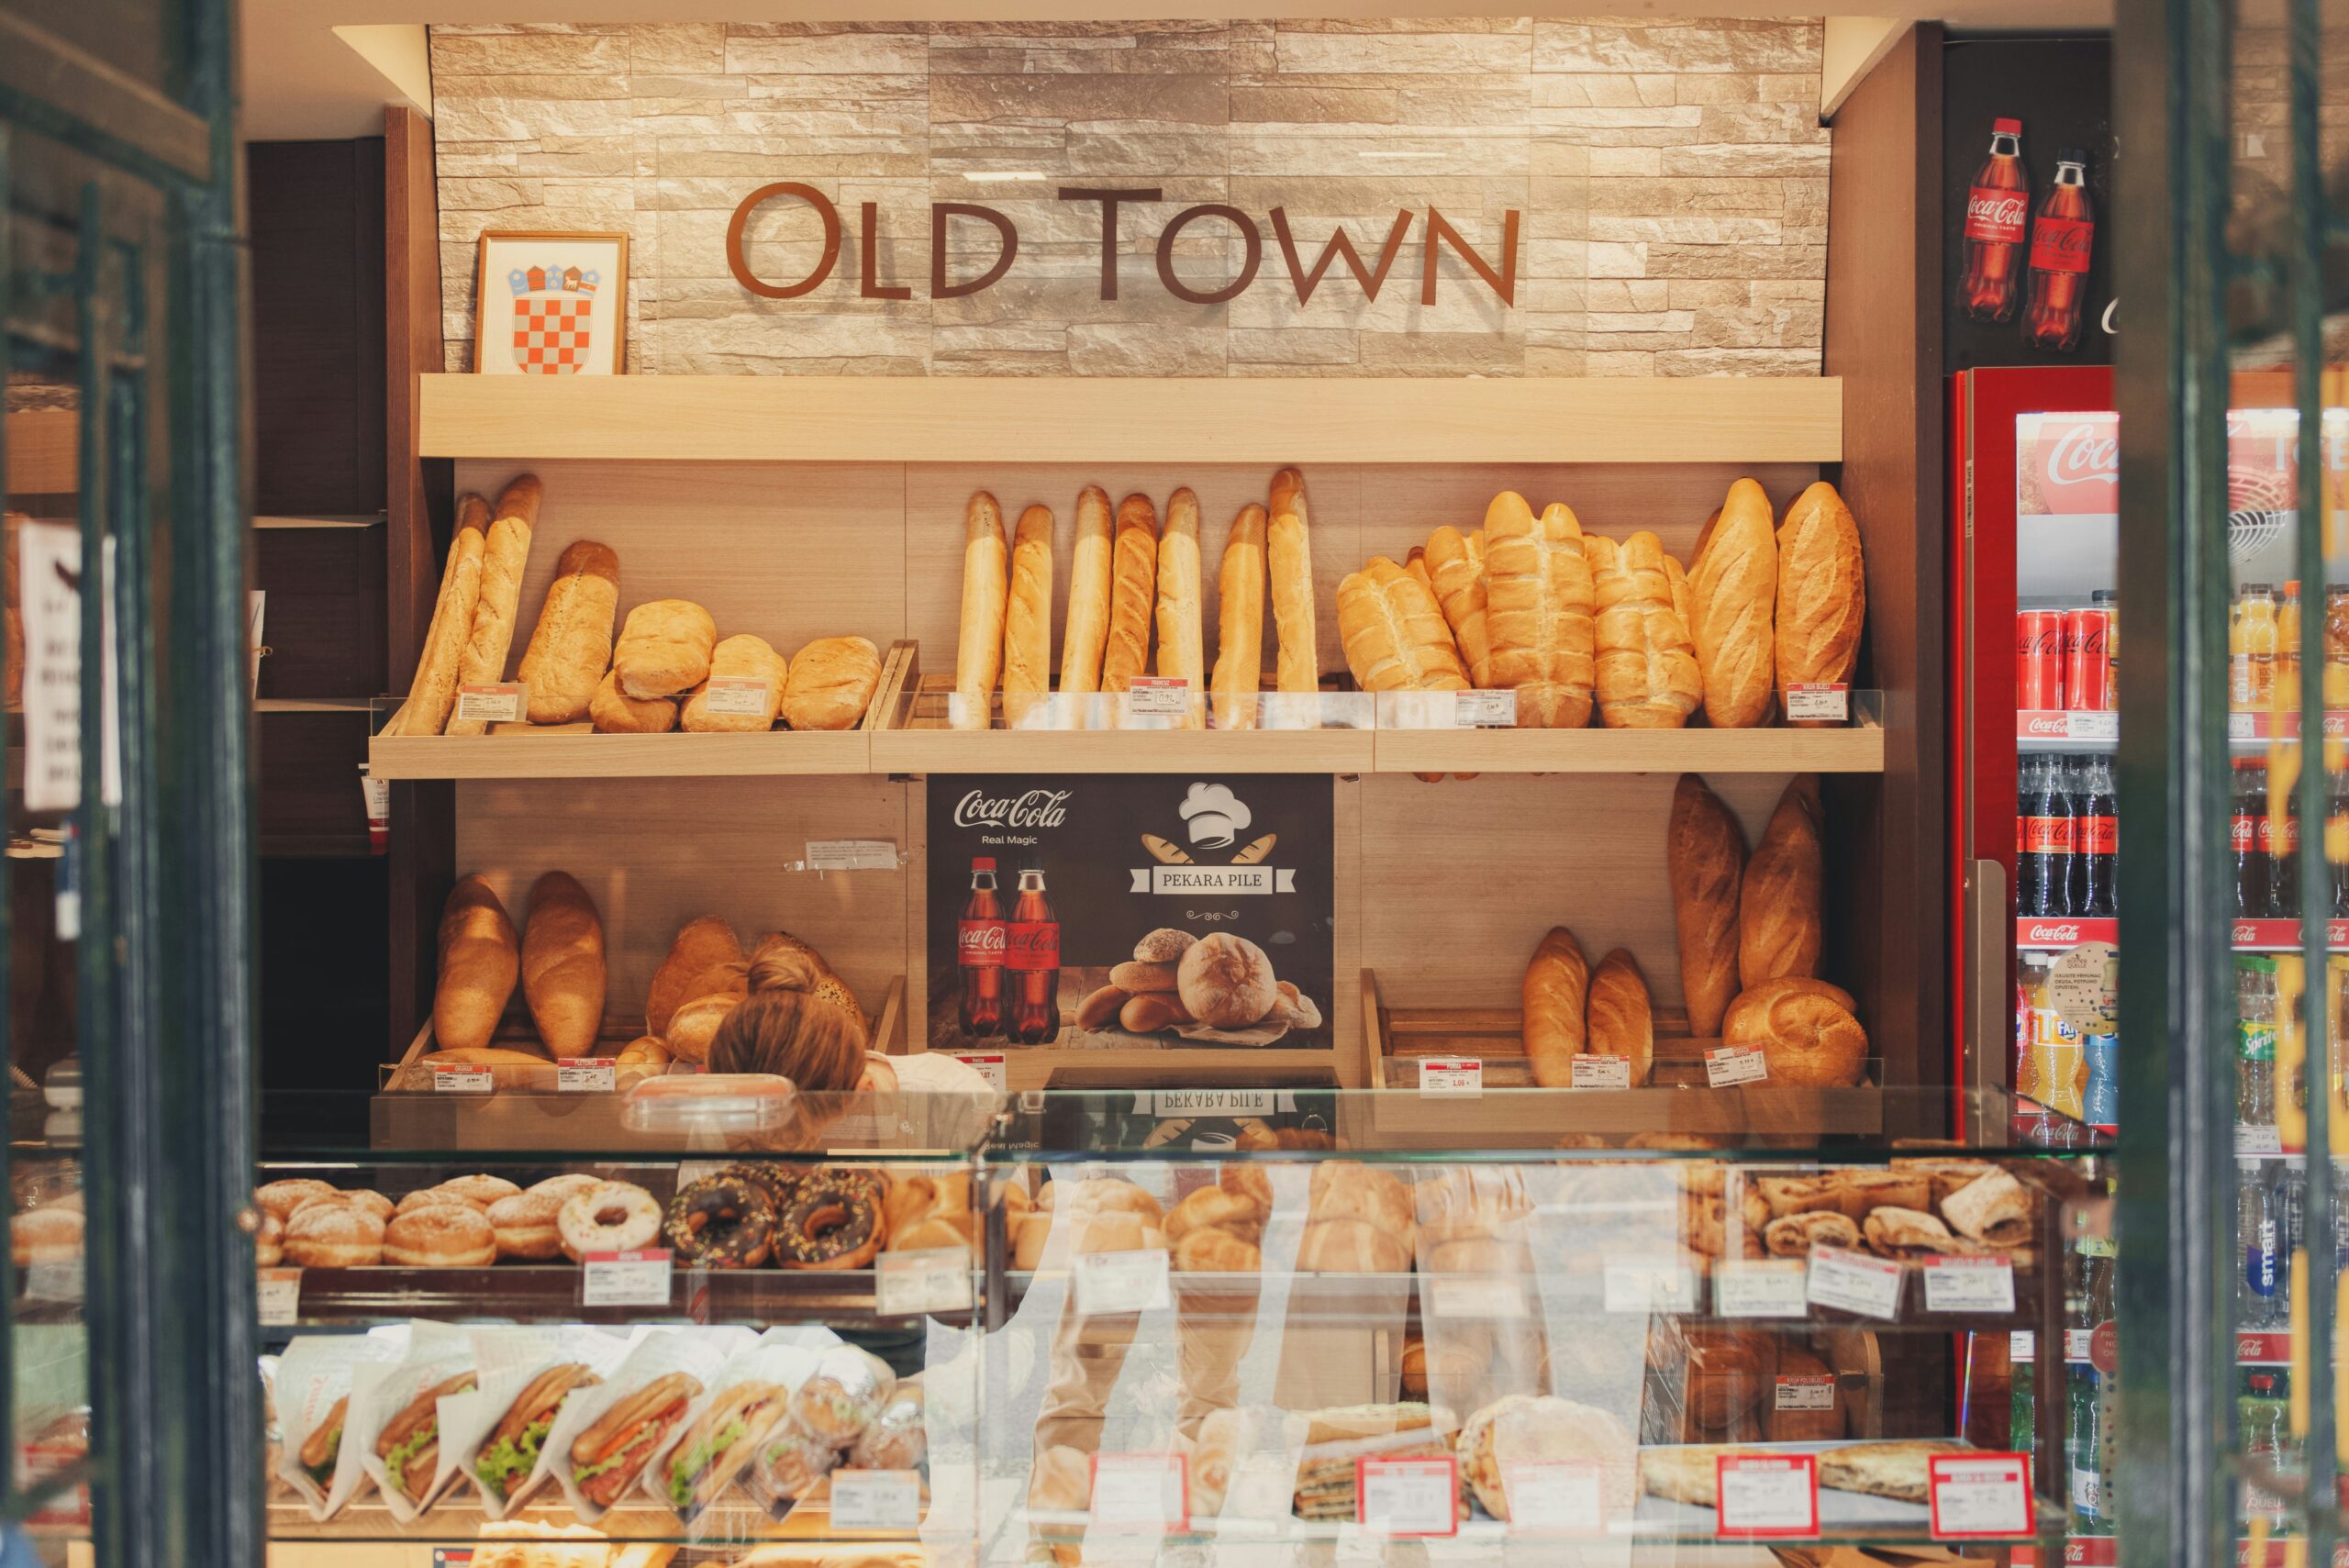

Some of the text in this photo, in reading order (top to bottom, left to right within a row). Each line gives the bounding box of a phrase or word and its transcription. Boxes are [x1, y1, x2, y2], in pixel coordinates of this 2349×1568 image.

[1967, 195, 2026, 226] Coca-Cola
[726, 182, 1520, 309] OLD TOWN
[954, 789, 1073, 828] Coca-Cola
[982, 836, 1038, 846] Real Magic
[1163, 873, 1263, 886] PEKARA PILE
[2030, 924, 2080, 941] Coca-Cola
